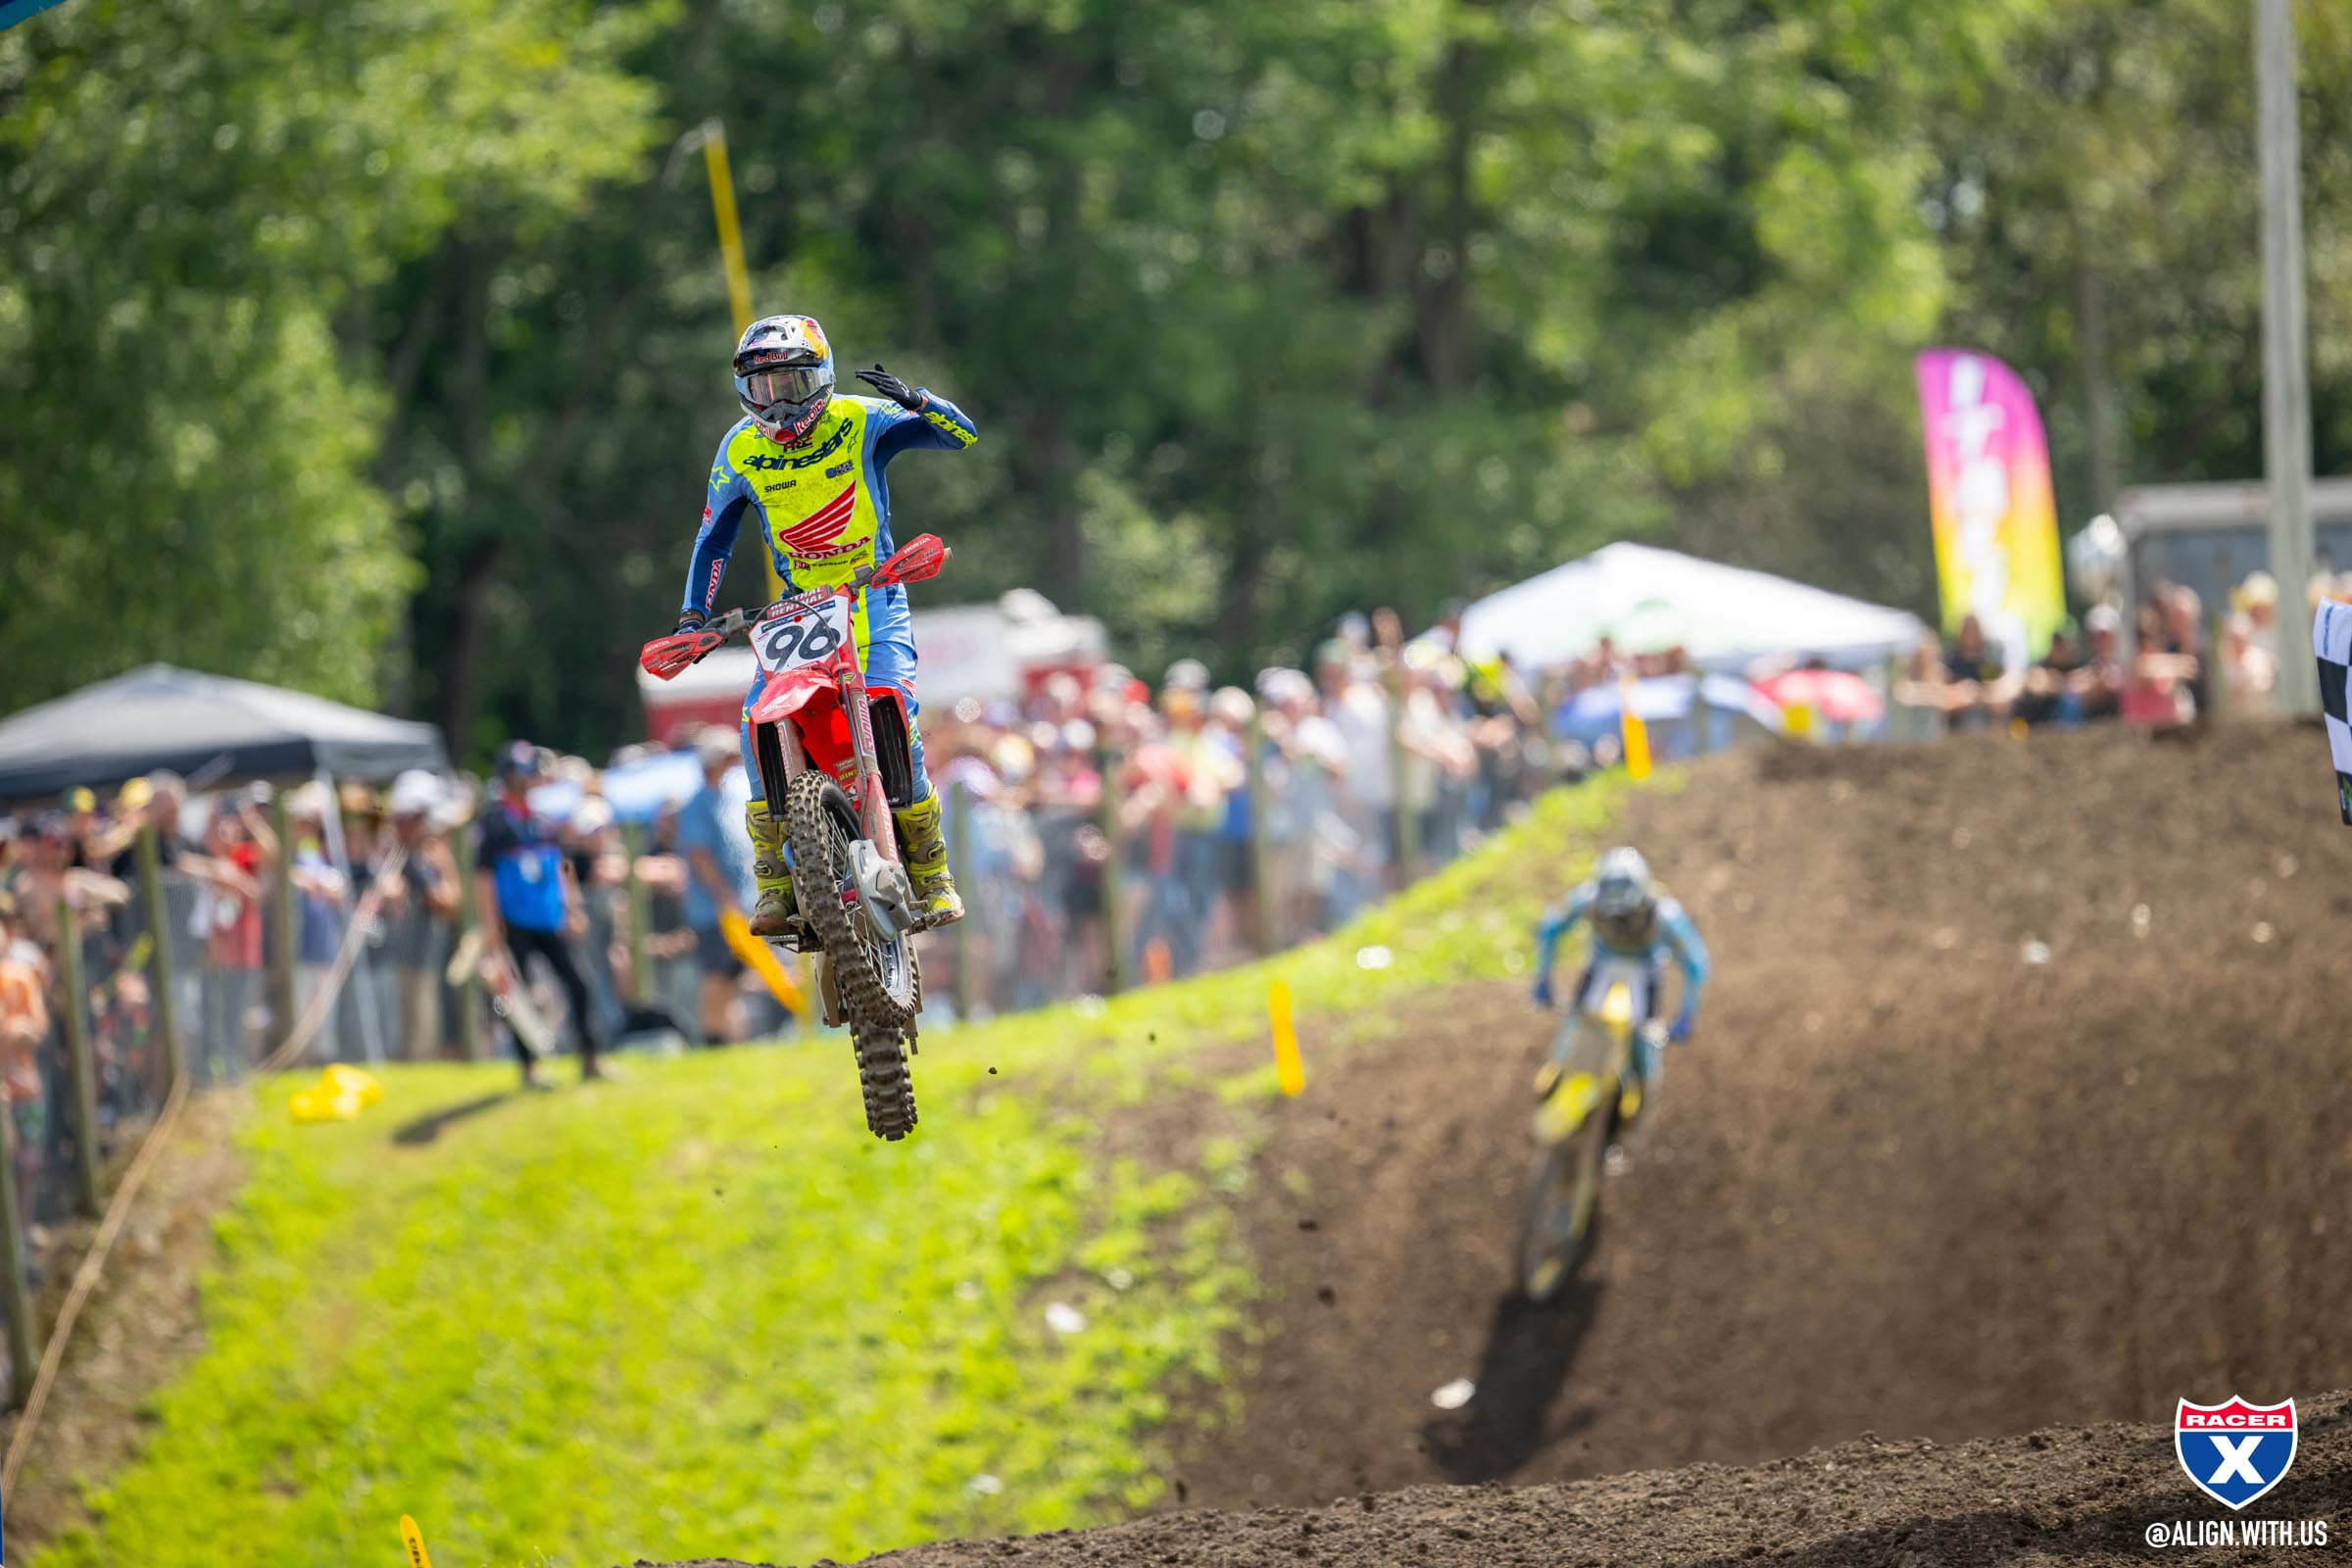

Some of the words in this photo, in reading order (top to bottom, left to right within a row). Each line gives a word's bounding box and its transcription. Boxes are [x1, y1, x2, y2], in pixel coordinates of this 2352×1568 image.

[754, 354, 770, 366] Red
[770, 351, 789, 363] Bull
[794, 405, 818, 436] Red
[743, 417, 854, 471] alpinestars
[764, 479, 797, 493] SHOWA
[786, 535, 871, 560] HONDA
[903, 537, 931, 554] HONDA
[645, 639, 670, 654] HONDA
[765, 612, 841, 673] 96
